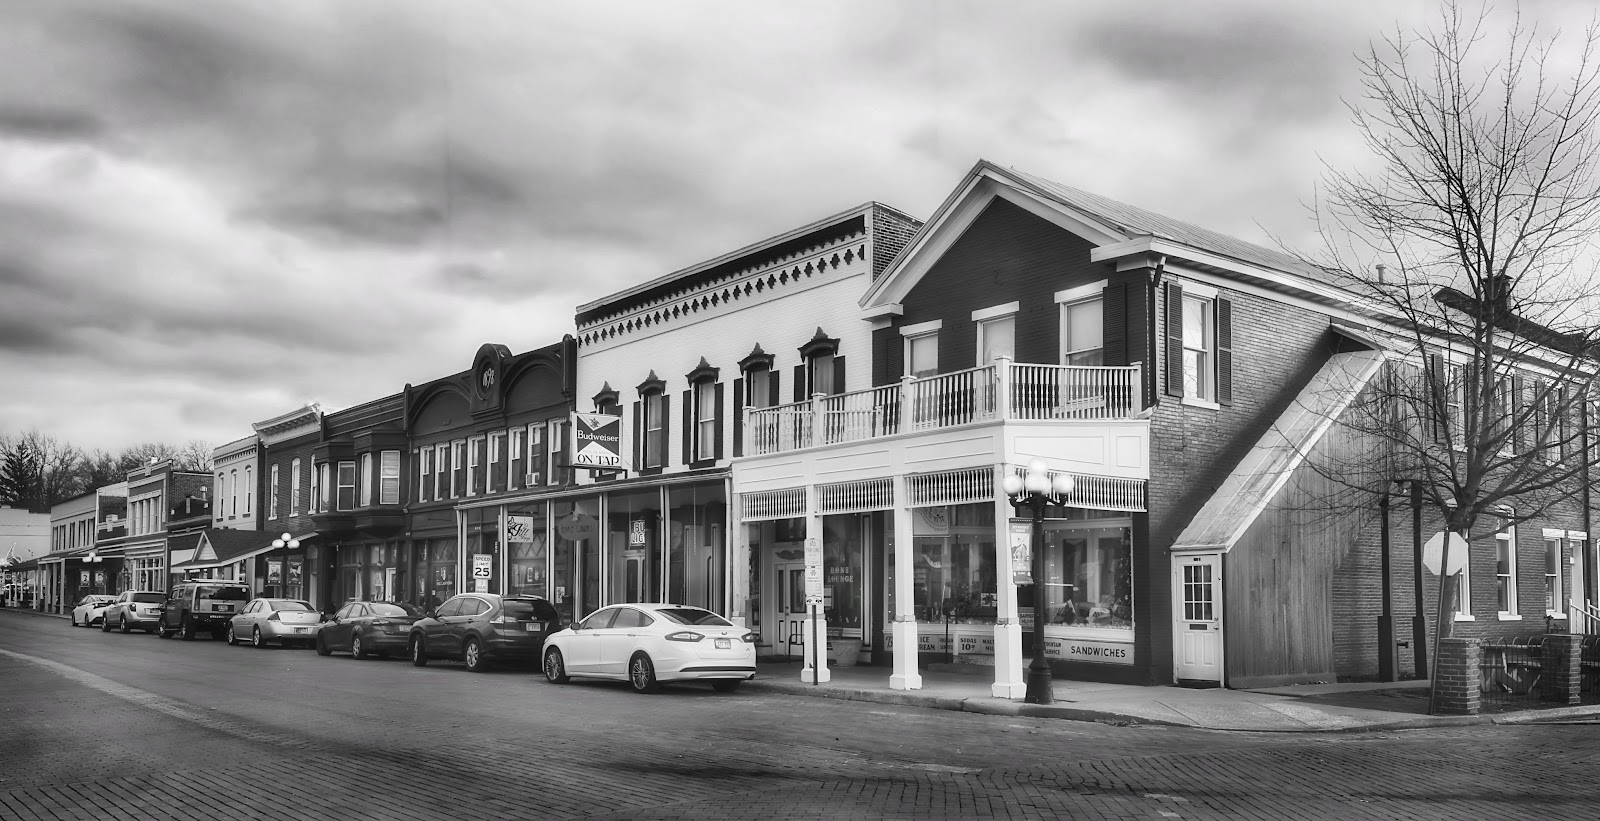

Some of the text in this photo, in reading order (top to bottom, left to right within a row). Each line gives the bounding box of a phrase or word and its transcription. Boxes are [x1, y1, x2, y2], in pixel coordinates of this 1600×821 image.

[482, 367, 495, 389] 1898
[577, 429, 619, 442] Budweiser
[577, 453, 620, 466] ON TAP
[474, 567, 490, 577] 25
[827, 575, 854, 583] LOUNGE
[1070, 645, 1126, 658] SANDWICHES
